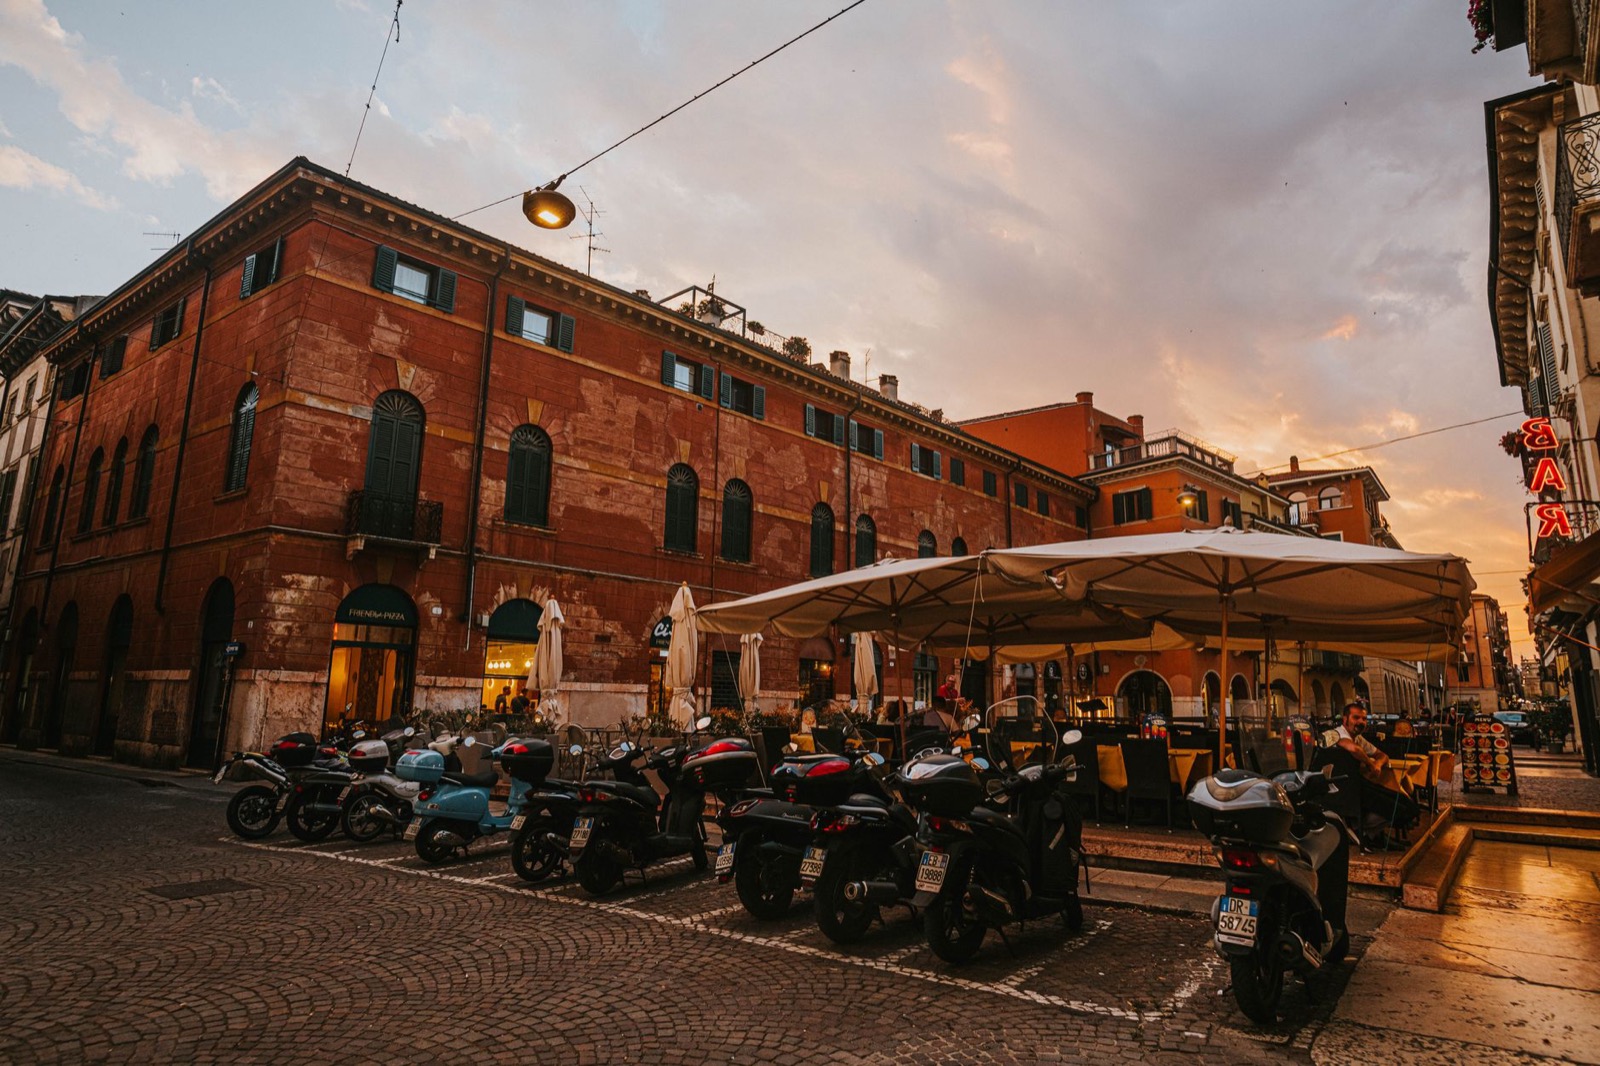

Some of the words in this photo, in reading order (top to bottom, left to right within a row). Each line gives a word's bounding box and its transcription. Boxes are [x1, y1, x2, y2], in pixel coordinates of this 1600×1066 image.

[384, 611, 404, 620] PIZZA
[920, 868, 943, 882] 19888
[1230, 898, 1243, 914] DR
[1220, 915, 1255, 934] 58745
